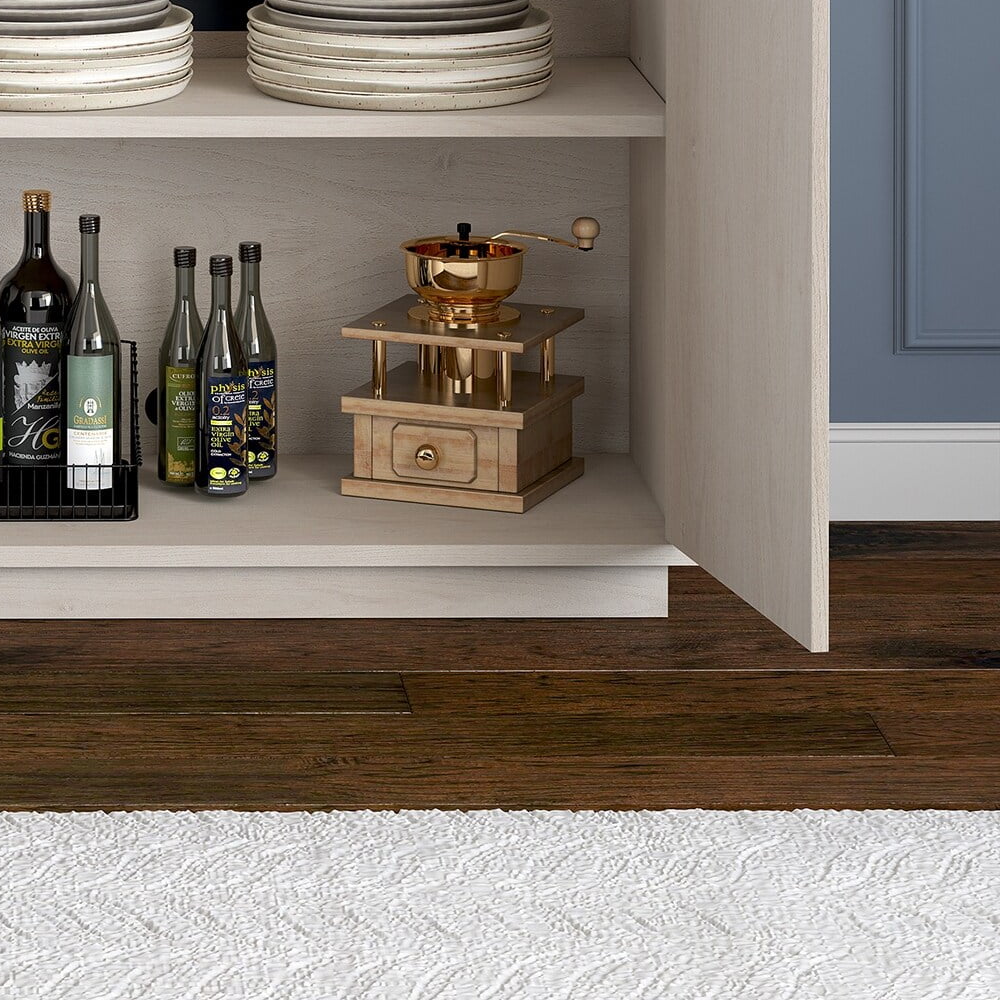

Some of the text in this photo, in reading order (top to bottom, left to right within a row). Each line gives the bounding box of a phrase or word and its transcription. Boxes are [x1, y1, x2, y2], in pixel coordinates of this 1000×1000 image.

[5, 330, 37, 340] VIRGEN
[7, 339, 34, 348] EXTRA
[210, 383, 246, 395] physis
[211, 405, 230, 416] 0.2
[73, 415, 107, 425] GRADASSI
[9, 451, 35, 460] HACIENDA
